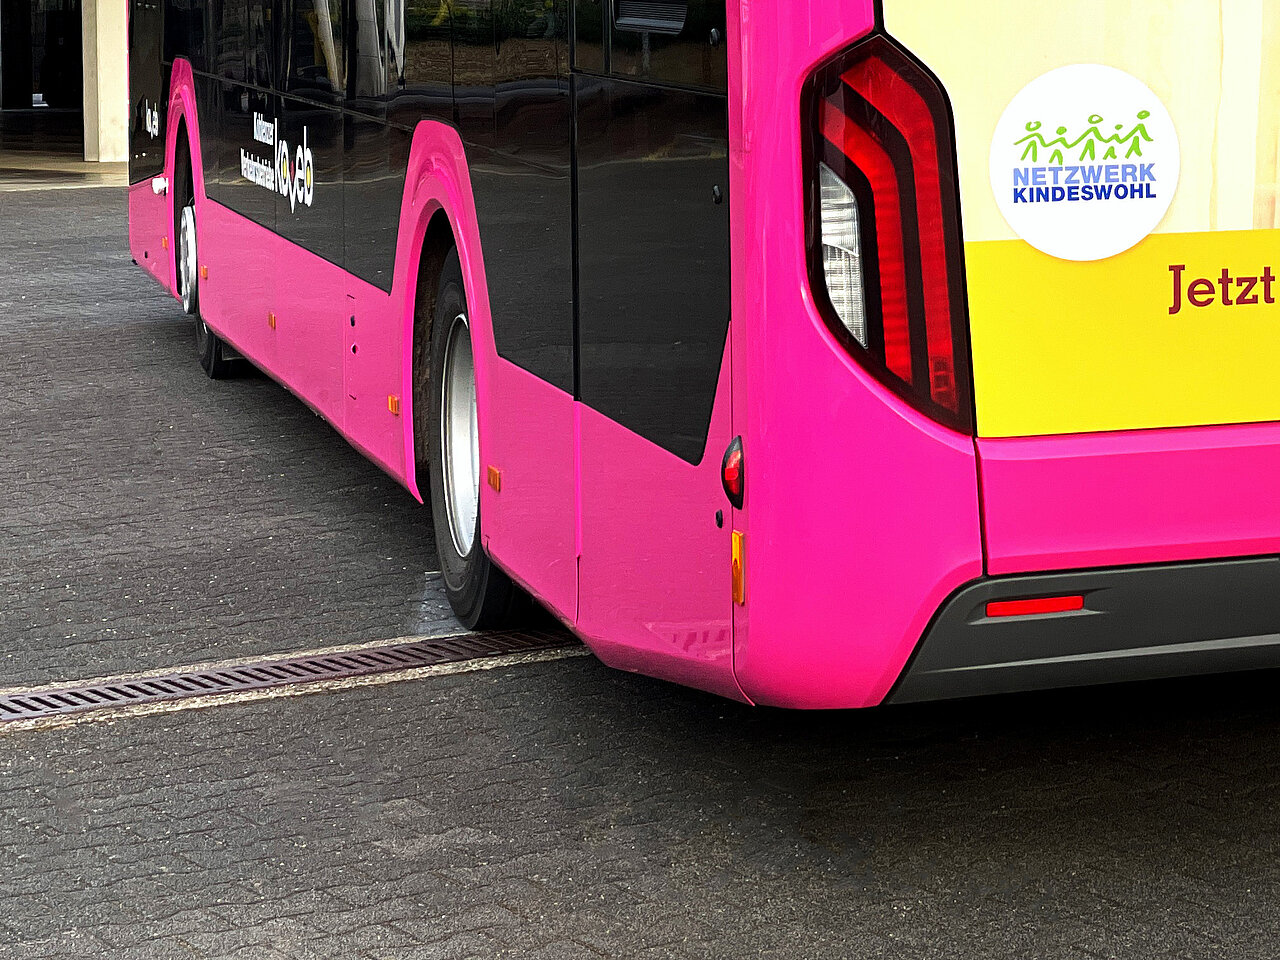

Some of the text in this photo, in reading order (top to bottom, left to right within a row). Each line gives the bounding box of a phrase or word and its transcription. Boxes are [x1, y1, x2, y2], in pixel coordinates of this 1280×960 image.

[1012, 162, 1157, 187] NETZWERK
[1012, 182, 1157, 204] KINDESWOHL
[1168, 263, 1276, 316] Jetzt
